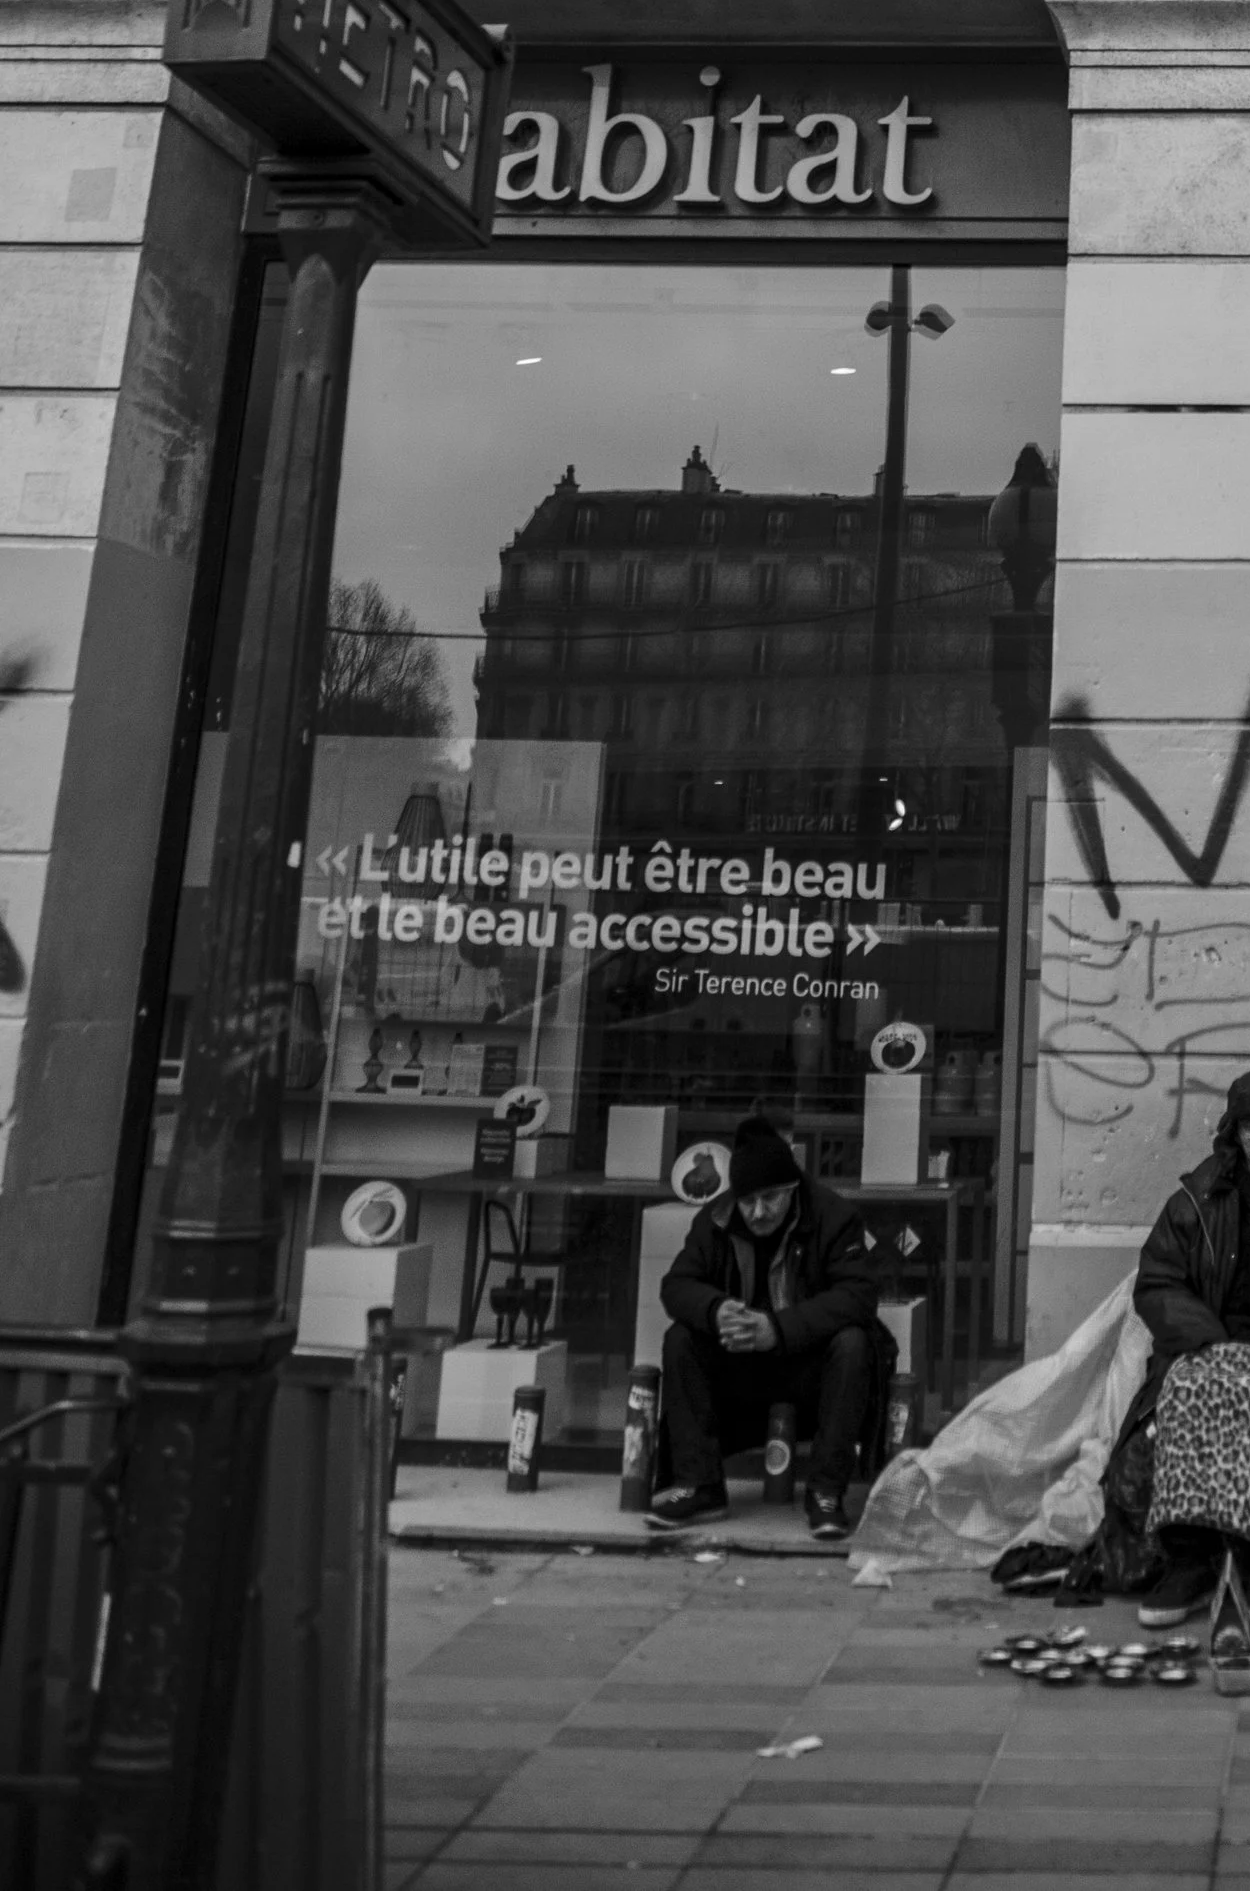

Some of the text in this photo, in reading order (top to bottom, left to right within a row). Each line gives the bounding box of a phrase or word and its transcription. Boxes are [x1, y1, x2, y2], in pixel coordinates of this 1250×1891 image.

[495, 64, 935, 207] abitat
[359, 833, 509, 886] L'utile
[519, 846, 634, 899] peut
[645, 840, 750, 895] être
[762, 847, 886, 900] beau
[317, 894, 367, 940] et
[377, 892, 424, 942] le
[434, 895, 558, 948] beau
[568, 904, 834, 958] accessible
[655, 968, 879, 1000] Sir Terence Conran
